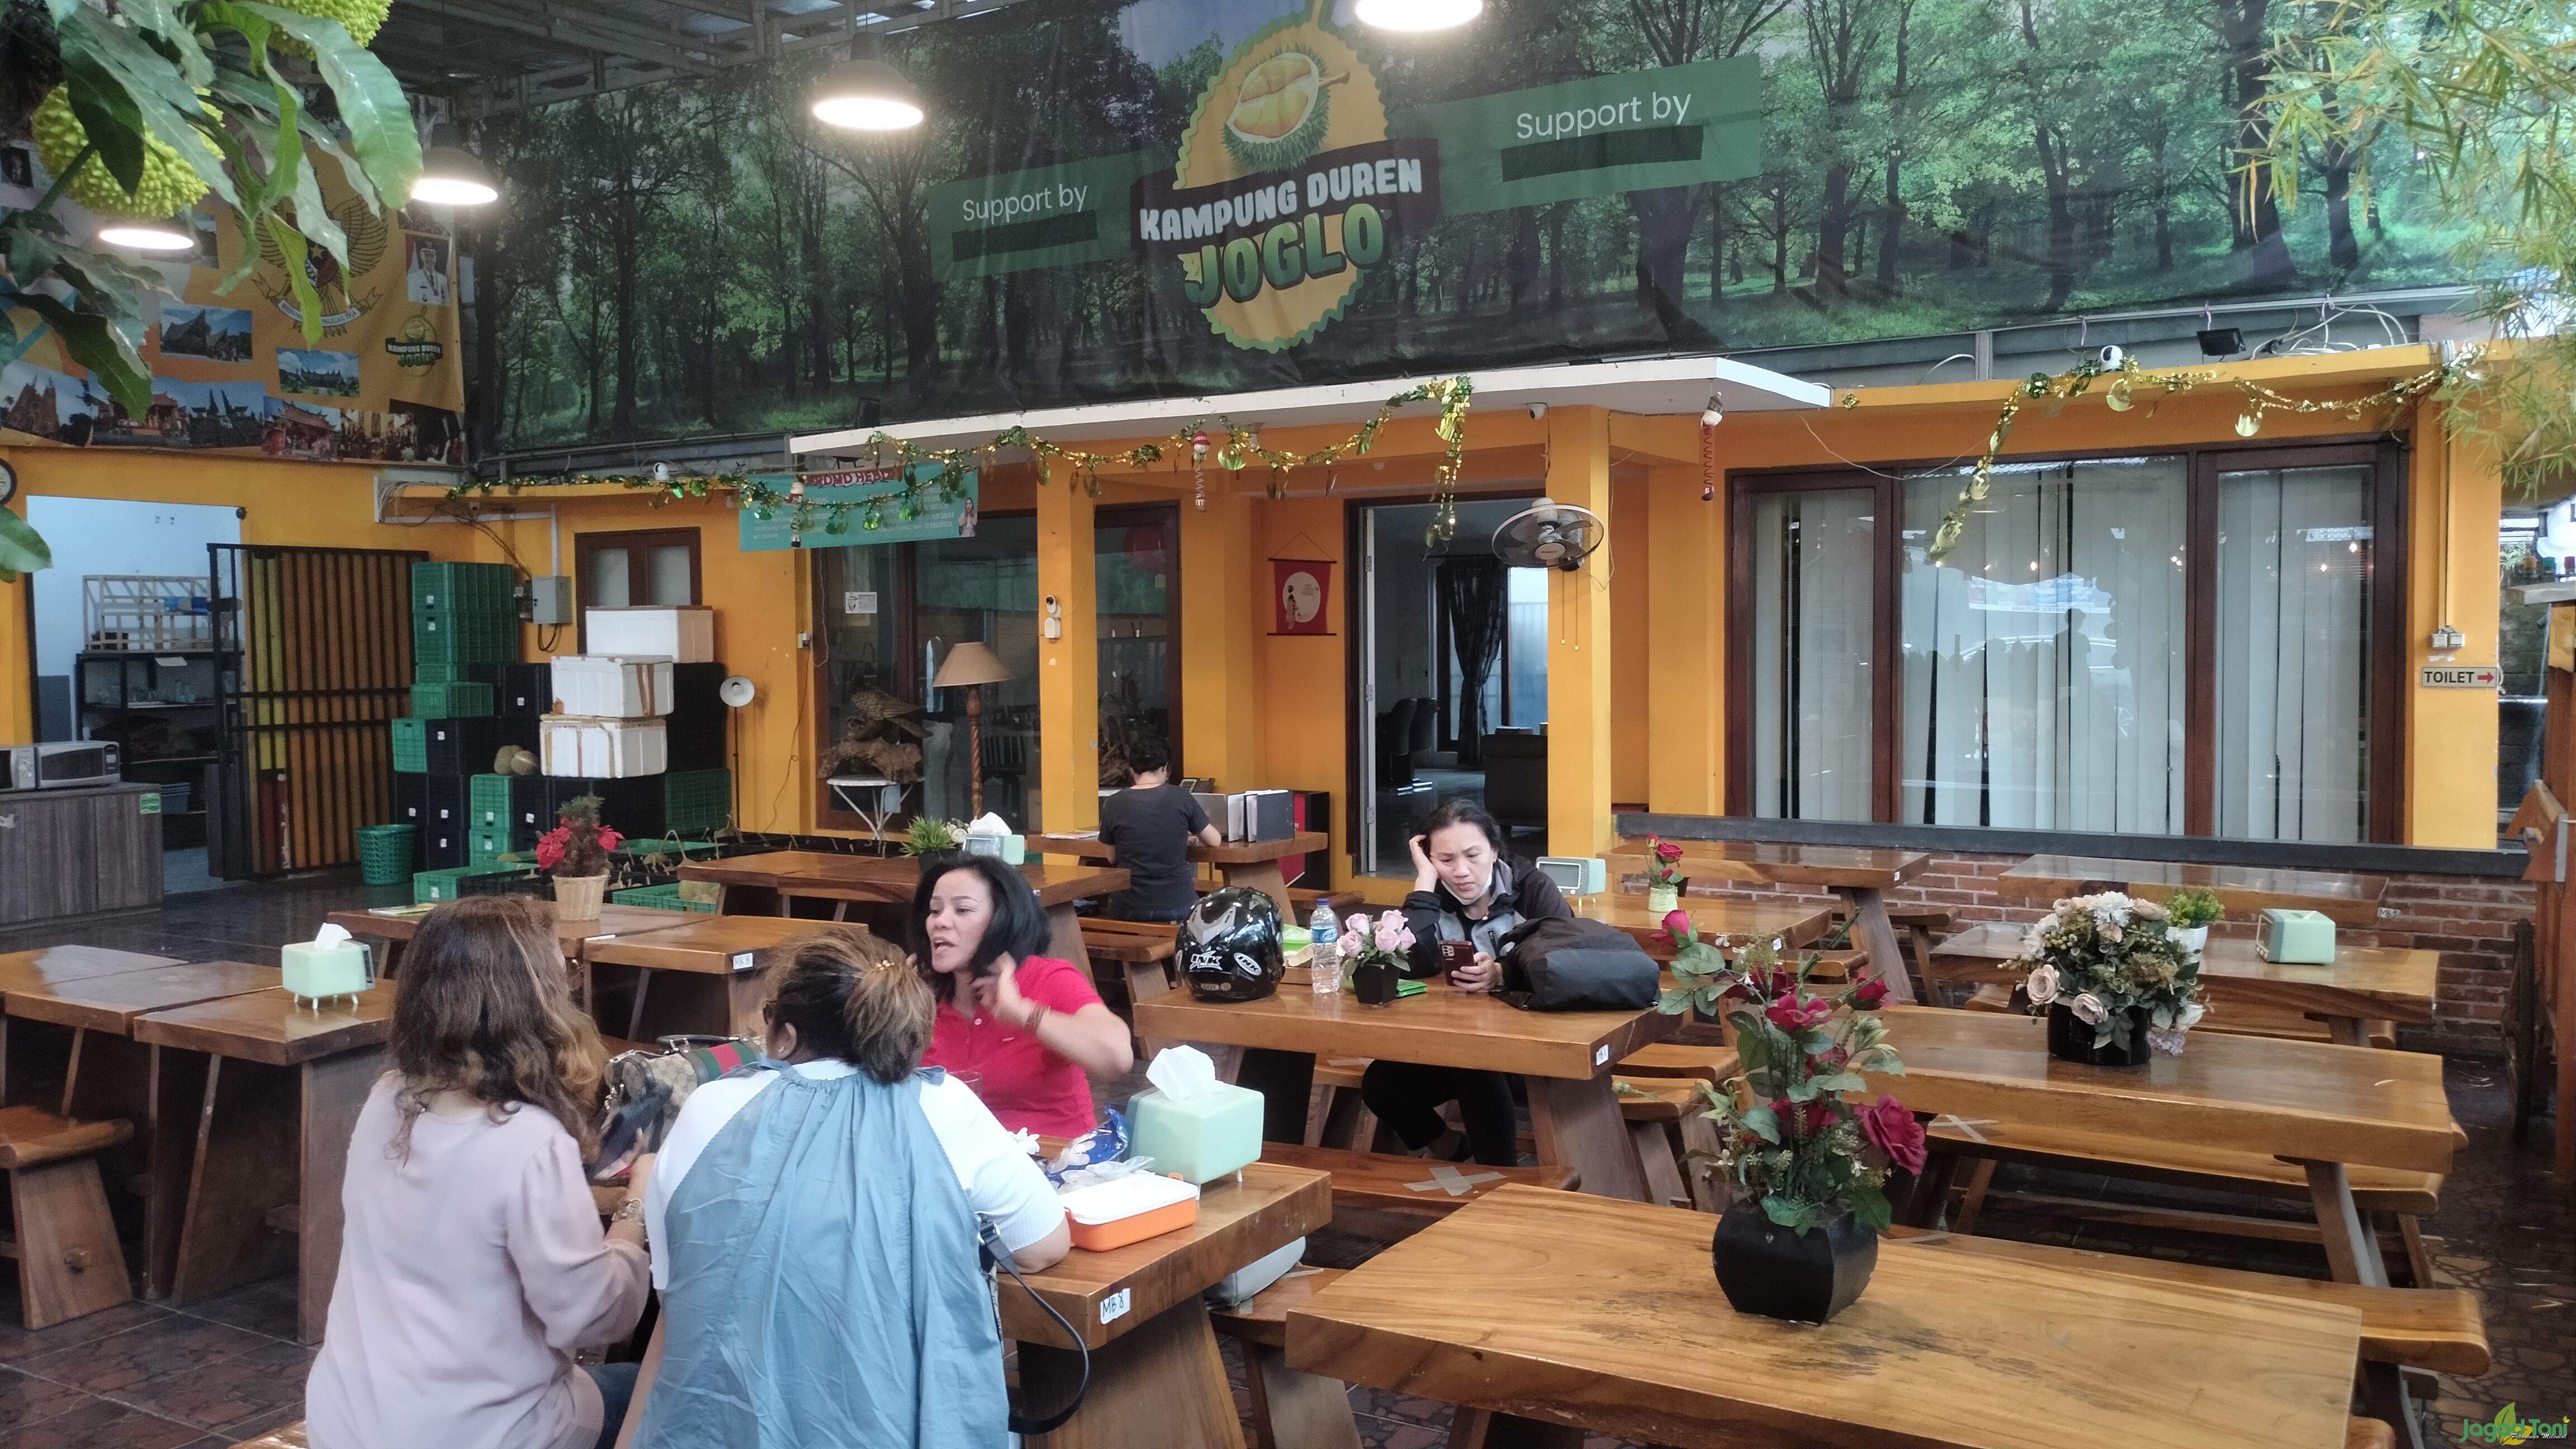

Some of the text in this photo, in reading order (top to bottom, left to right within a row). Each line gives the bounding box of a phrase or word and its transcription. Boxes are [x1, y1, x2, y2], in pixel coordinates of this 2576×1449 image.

[1516, 91, 1692, 140] Support by
[962, 182, 1088, 224] Support by
[1139, 158, 1423, 242] KAMPUNG DUREN
[1183, 202, 1385, 309] JOGLO
[387, 344, 420, 353] KAMPUNG
[2423, 671, 2475, 683] TOILET
[1190, 950, 1223, 970] INK
[1238, 955, 1259, 972] INK
[1118, 1292, 1124, 1309] 8
